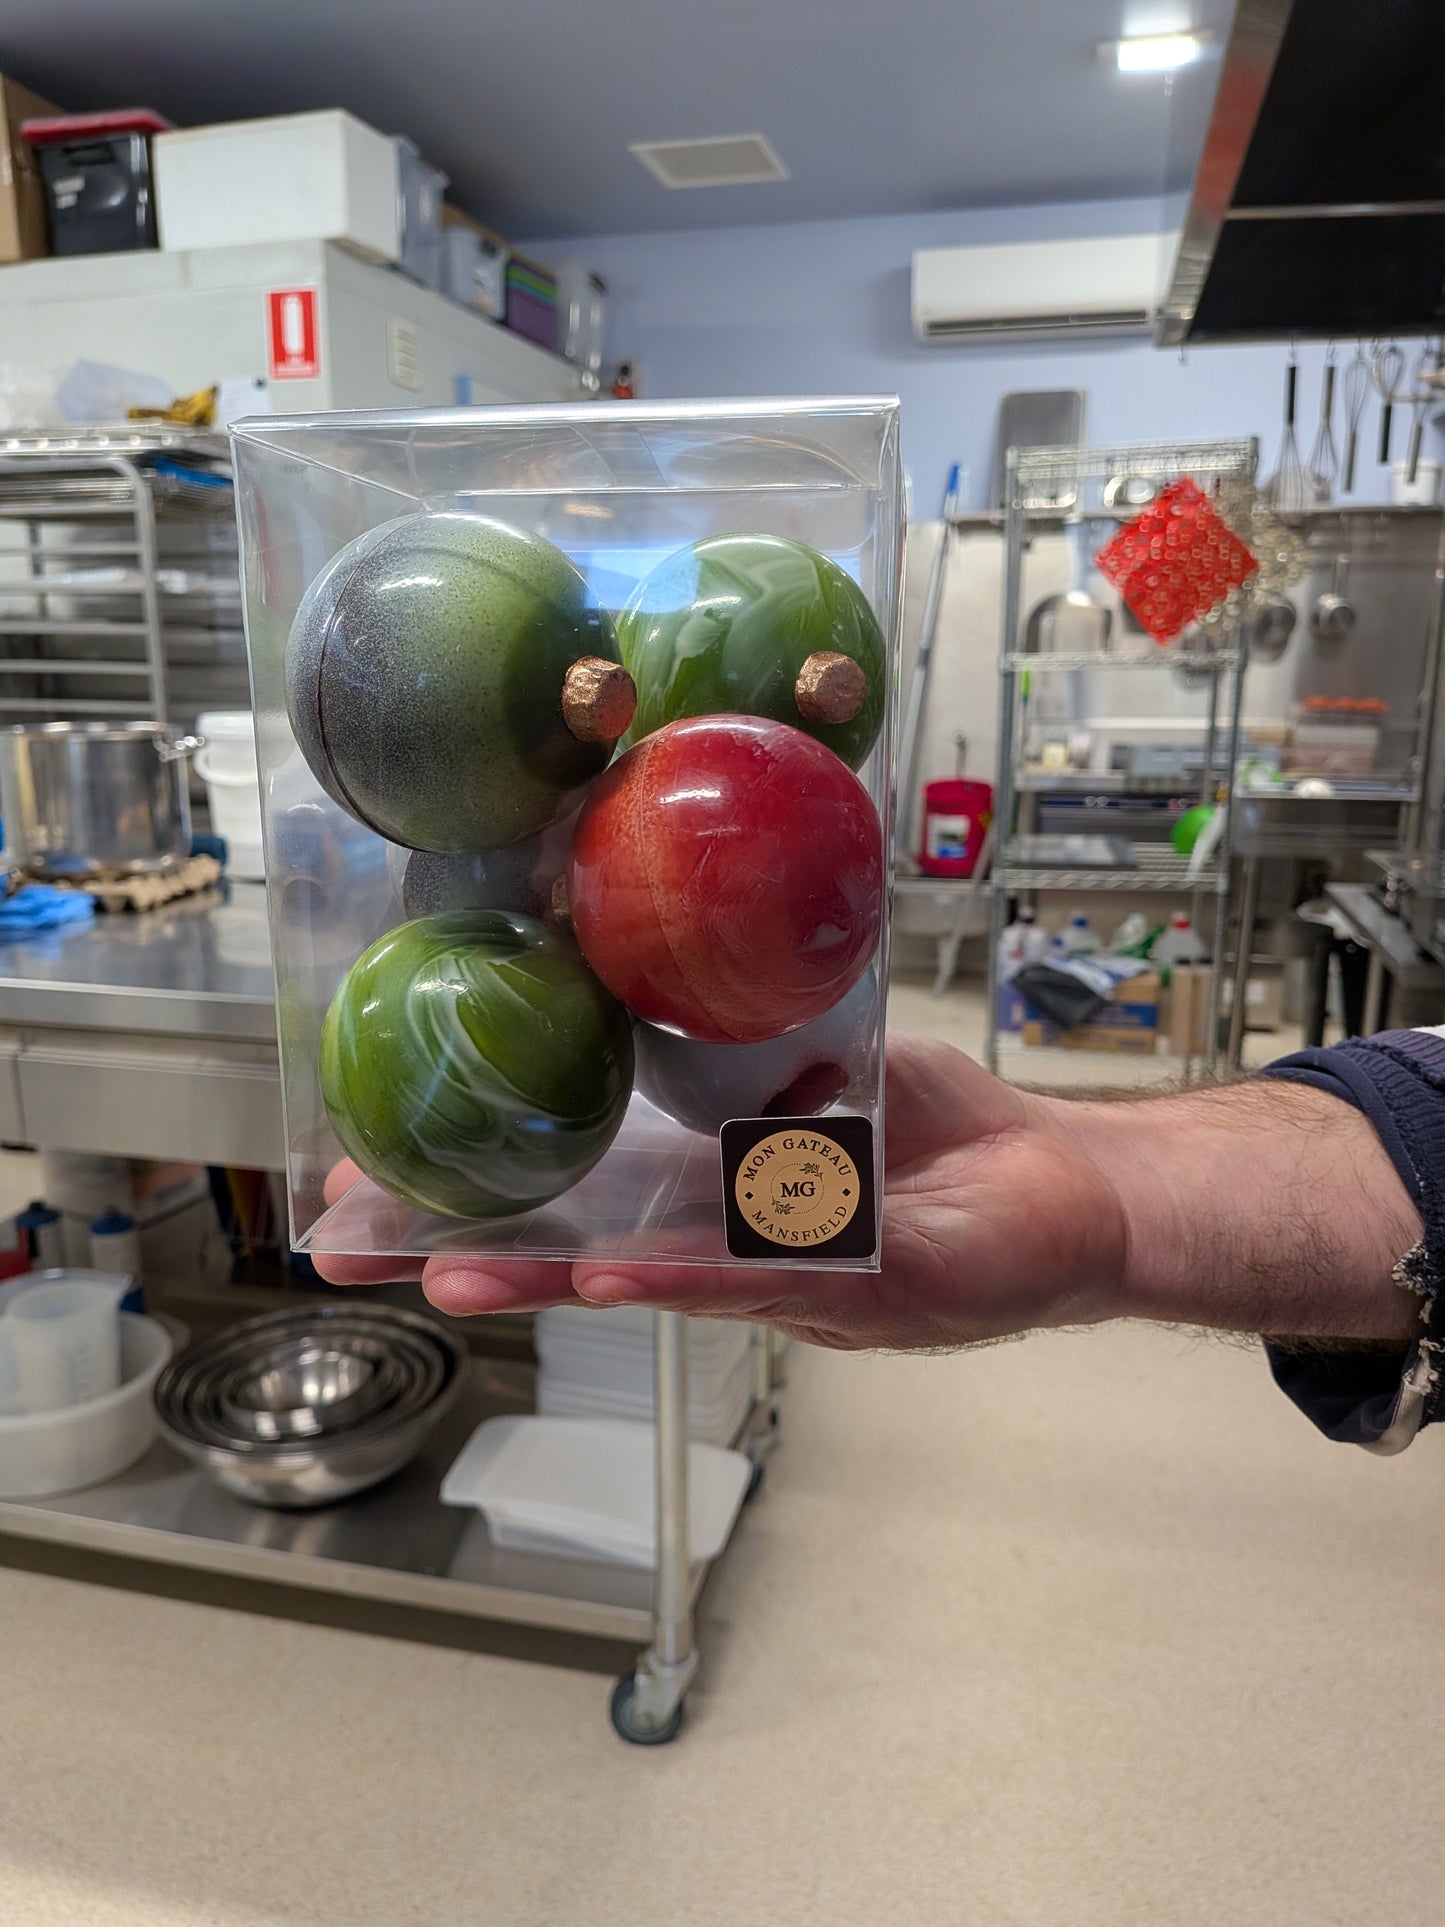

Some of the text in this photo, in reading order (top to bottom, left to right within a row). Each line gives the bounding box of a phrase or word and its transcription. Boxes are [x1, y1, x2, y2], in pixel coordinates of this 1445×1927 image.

[743, 1138, 852, 1181] MON GATEAU
[780, 1181, 816, 1198] MG
[752, 1206, 847, 1242] MANSFIELD
